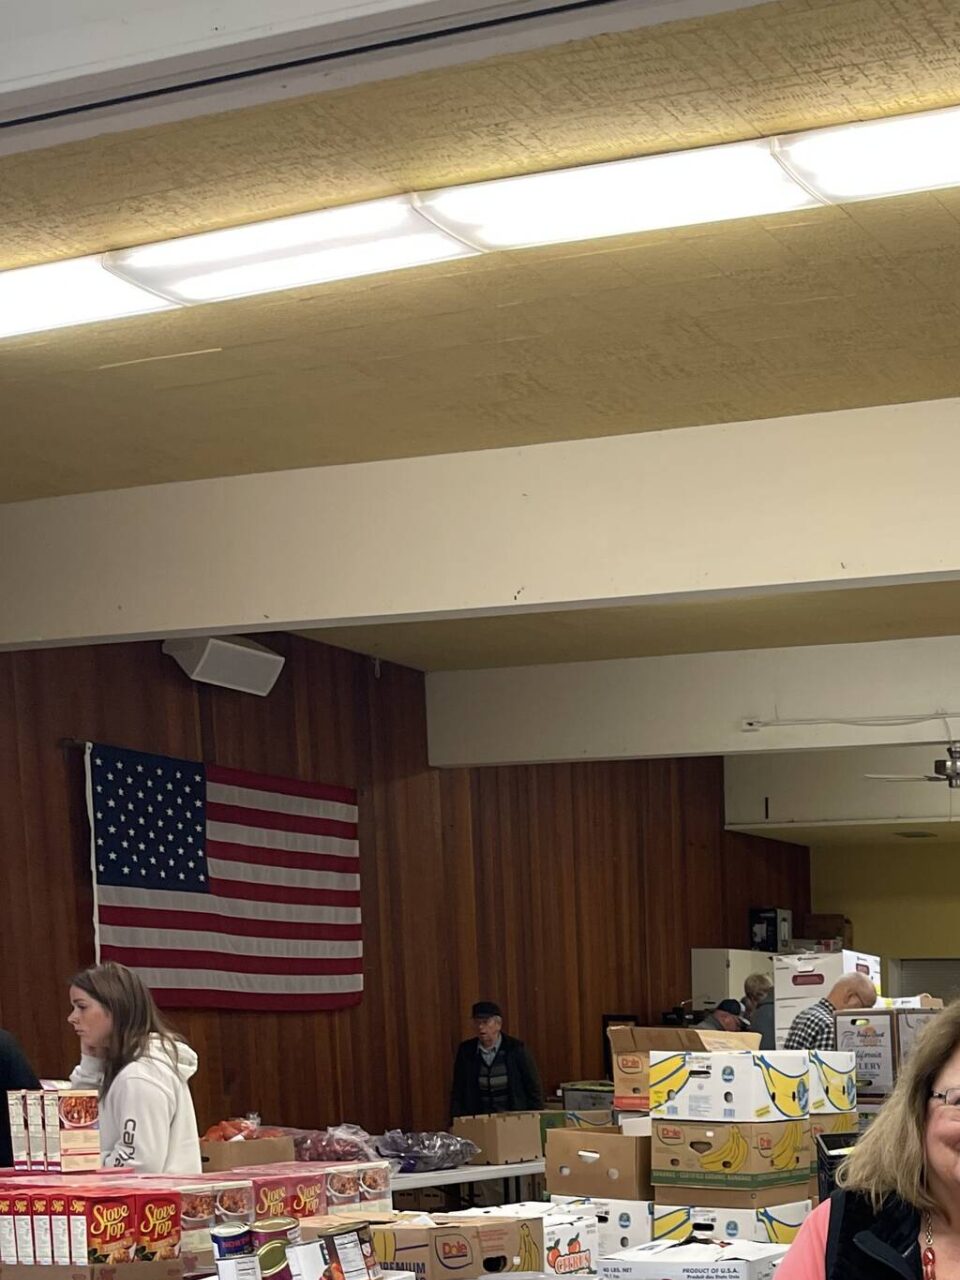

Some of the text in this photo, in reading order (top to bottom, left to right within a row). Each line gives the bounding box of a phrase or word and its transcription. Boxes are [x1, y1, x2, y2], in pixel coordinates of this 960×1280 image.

[257, 1184, 286, 1214] Stove
[294, 1183, 321, 1210] Stove
[270, 1202, 284, 1217] Top
[305, 1198, 320, 1214] Top
[90, 1204, 130, 1234] Stove
[140, 1204, 177, 1233] Stove
[106, 1220, 125, 1238] Top
[154, 1220, 173, 1238] Top
[442, 1241, 468, 1255] Dole
